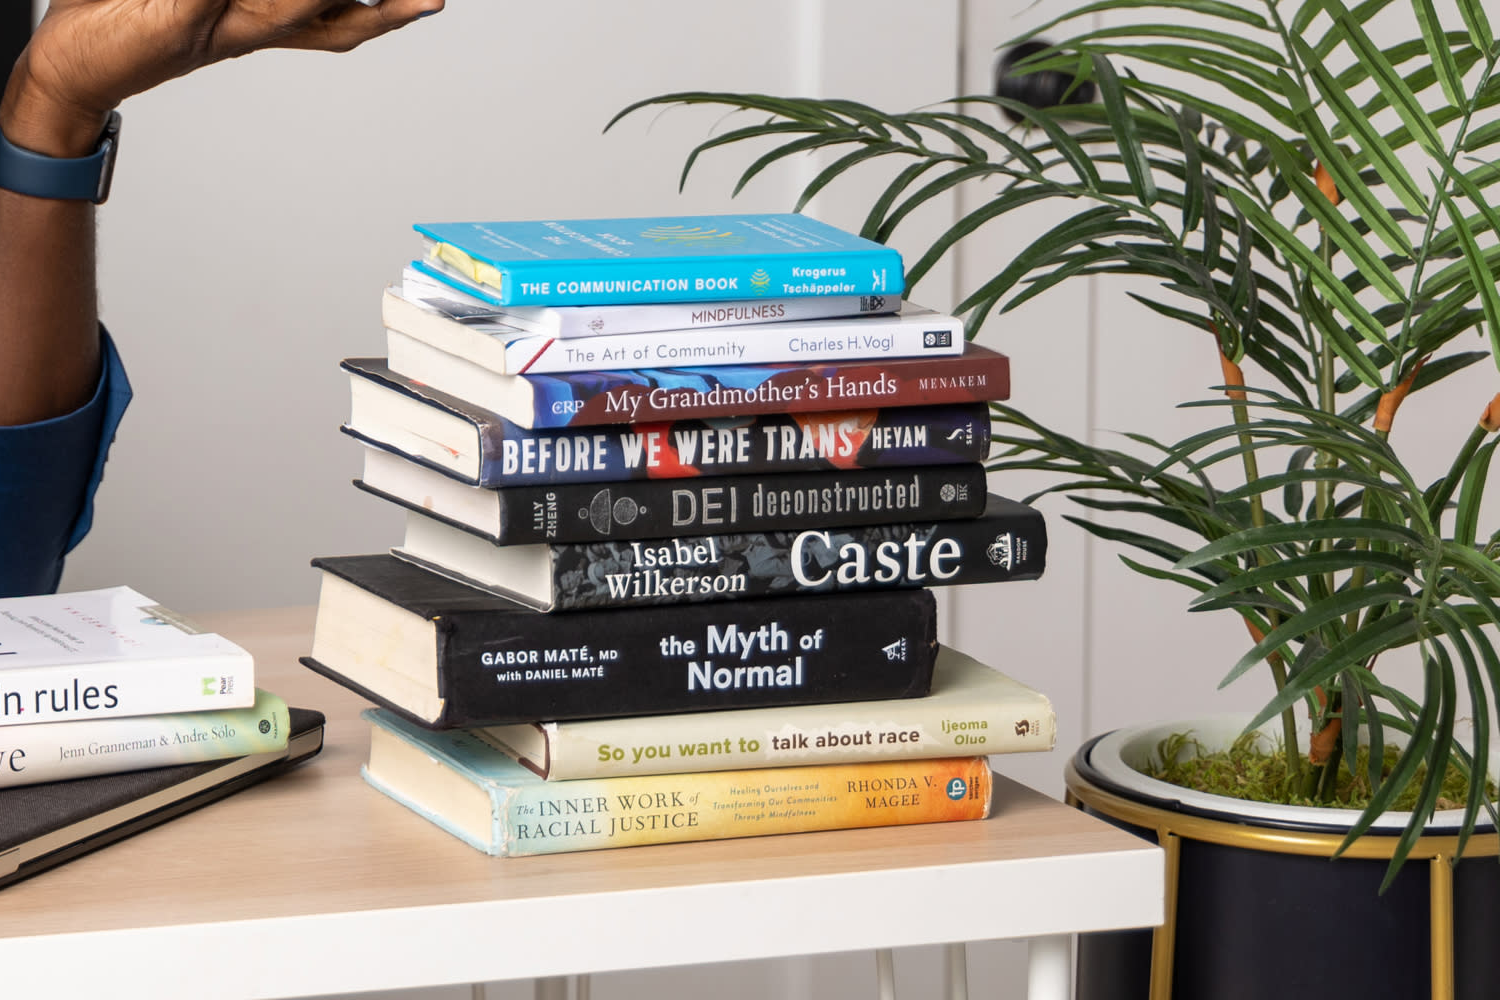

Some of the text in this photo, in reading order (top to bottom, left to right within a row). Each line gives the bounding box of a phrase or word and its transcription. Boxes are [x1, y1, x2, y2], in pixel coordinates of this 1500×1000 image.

[792, 266, 847, 280] Krogerus
[521, 276, 739, 295] THE COMMUNICATION BOOK
[783, 280, 856, 296] Tschäppeler
[691, 303, 785, 325] MINDFULNESS
[565, 341, 745, 363] The Art of Community
[788, 337, 843, 352] Charles
[863, 334, 894, 352] Vogl
[919, 375, 987, 390] MENAKEM
[604, 372, 897, 418] My Grandmother's Hands
[551, 400, 585, 415] CRP
[872, 425, 927, 450] HEYAM
[965, 421, 973, 445] SEAL
[502, 422, 853, 475] BEFORE WE WERE TRANS
[672, 474, 920, 527] DEI deconstructed
[959, 484, 968, 501] BK
[533, 501, 544, 530] LILY
[546, 492, 557, 538] ZHENG
[631, 537, 718, 568] Isabel
[790, 530, 961, 588] Caste
[605, 570, 746, 600] Wilkerson
[660, 621, 823, 660] the Myth of
[481, 646, 618, 666] GABOR MATÉ, MD
[497, 666, 604, 682] with DANIEL MATÉ
[688, 656, 802, 691] Normal
[35, 678, 119, 713] rules
[941, 719, 988, 734] Ijeoma
[60, 746, 85, 762] Jenn
[88, 738, 157, 756] Granneman
[159, 735, 169, 747] &
[172, 727, 208, 745] Andre
[597, 728, 921, 764] So you want to talk about race
[954, 733, 987, 746] Oluo
[764, 783, 802, 793] Ourselves
[847, 775, 938, 793] RHONDA V.
[948, 779, 965, 797] tp
[516, 791, 700, 816] The INNER WORK of
[865, 793, 920, 809] MAGEE
[516, 811, 700, 840] RACIAL JUSTICE
